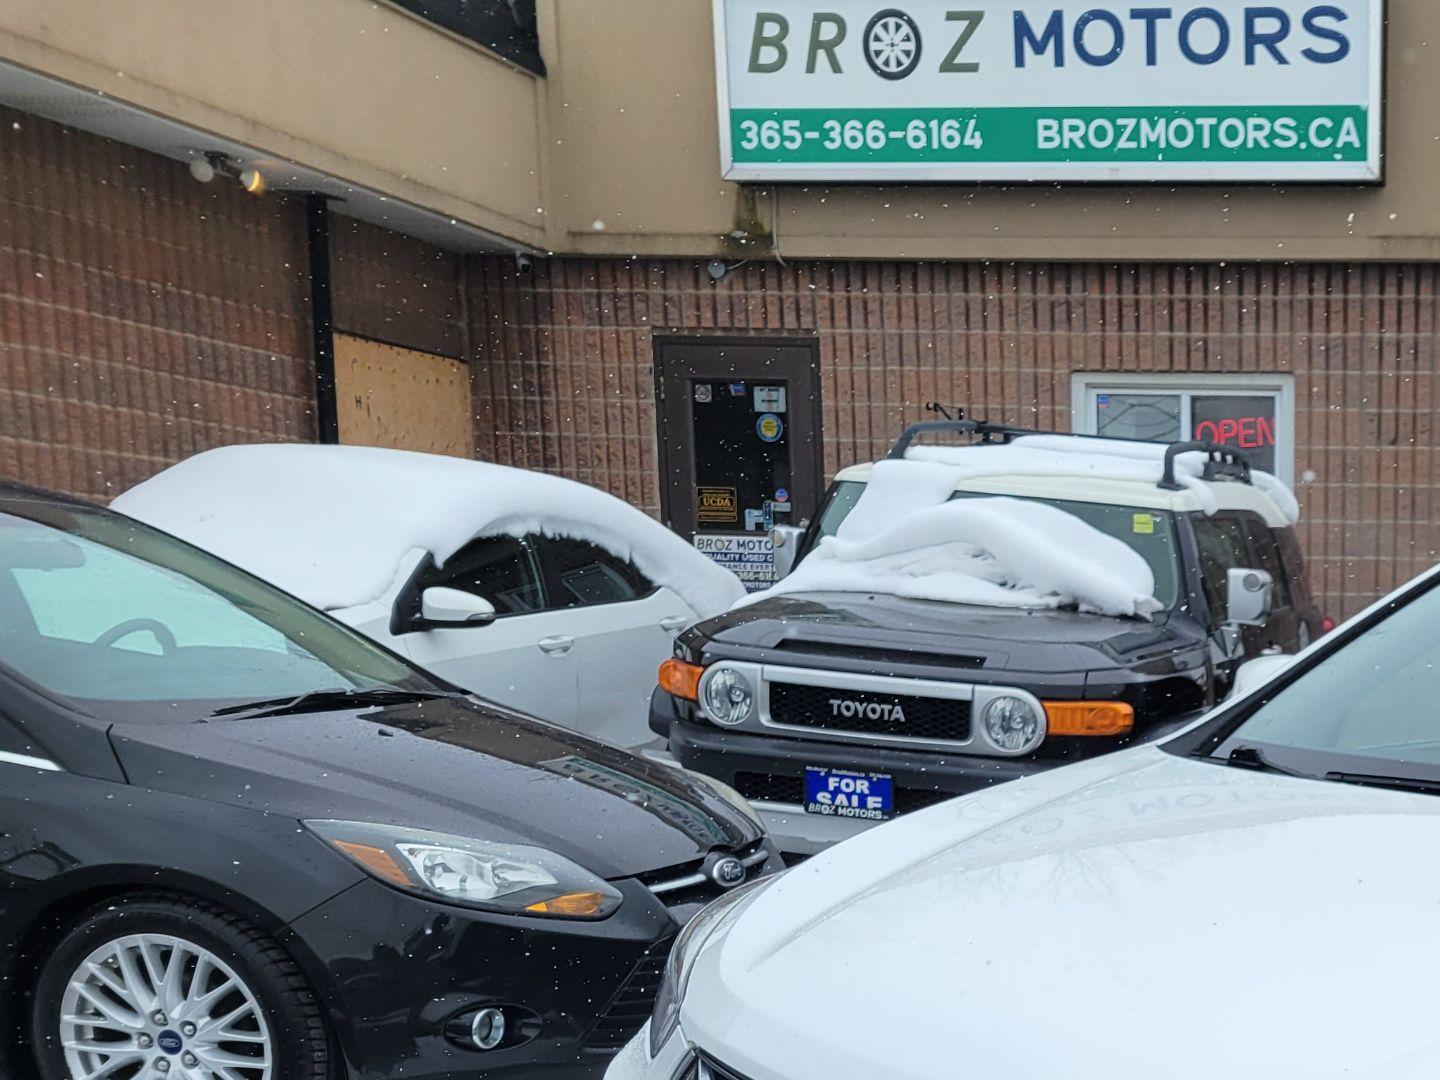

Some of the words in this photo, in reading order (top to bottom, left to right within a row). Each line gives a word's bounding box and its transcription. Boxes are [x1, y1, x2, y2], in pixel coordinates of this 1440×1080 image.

[748, 8, 986, 82] BROZ
[1013, 5, 1350, 69] MOTORS
[740, 118, 984, 151] 365-366-6164
[1036, 116, 1361, 150] BROZMOTORS.CA
[1195, 417, 1276, 448] OPEN
[703, 496, 731, 506] UCDA
[697, 538, 733, 551] BROZ
[737, 540, 774, 551] MOTO
[828, 699, 906, 723] TOYOTA
[828, 776, 870, 795] FOR
[816, 791, 883, 809] SALE
